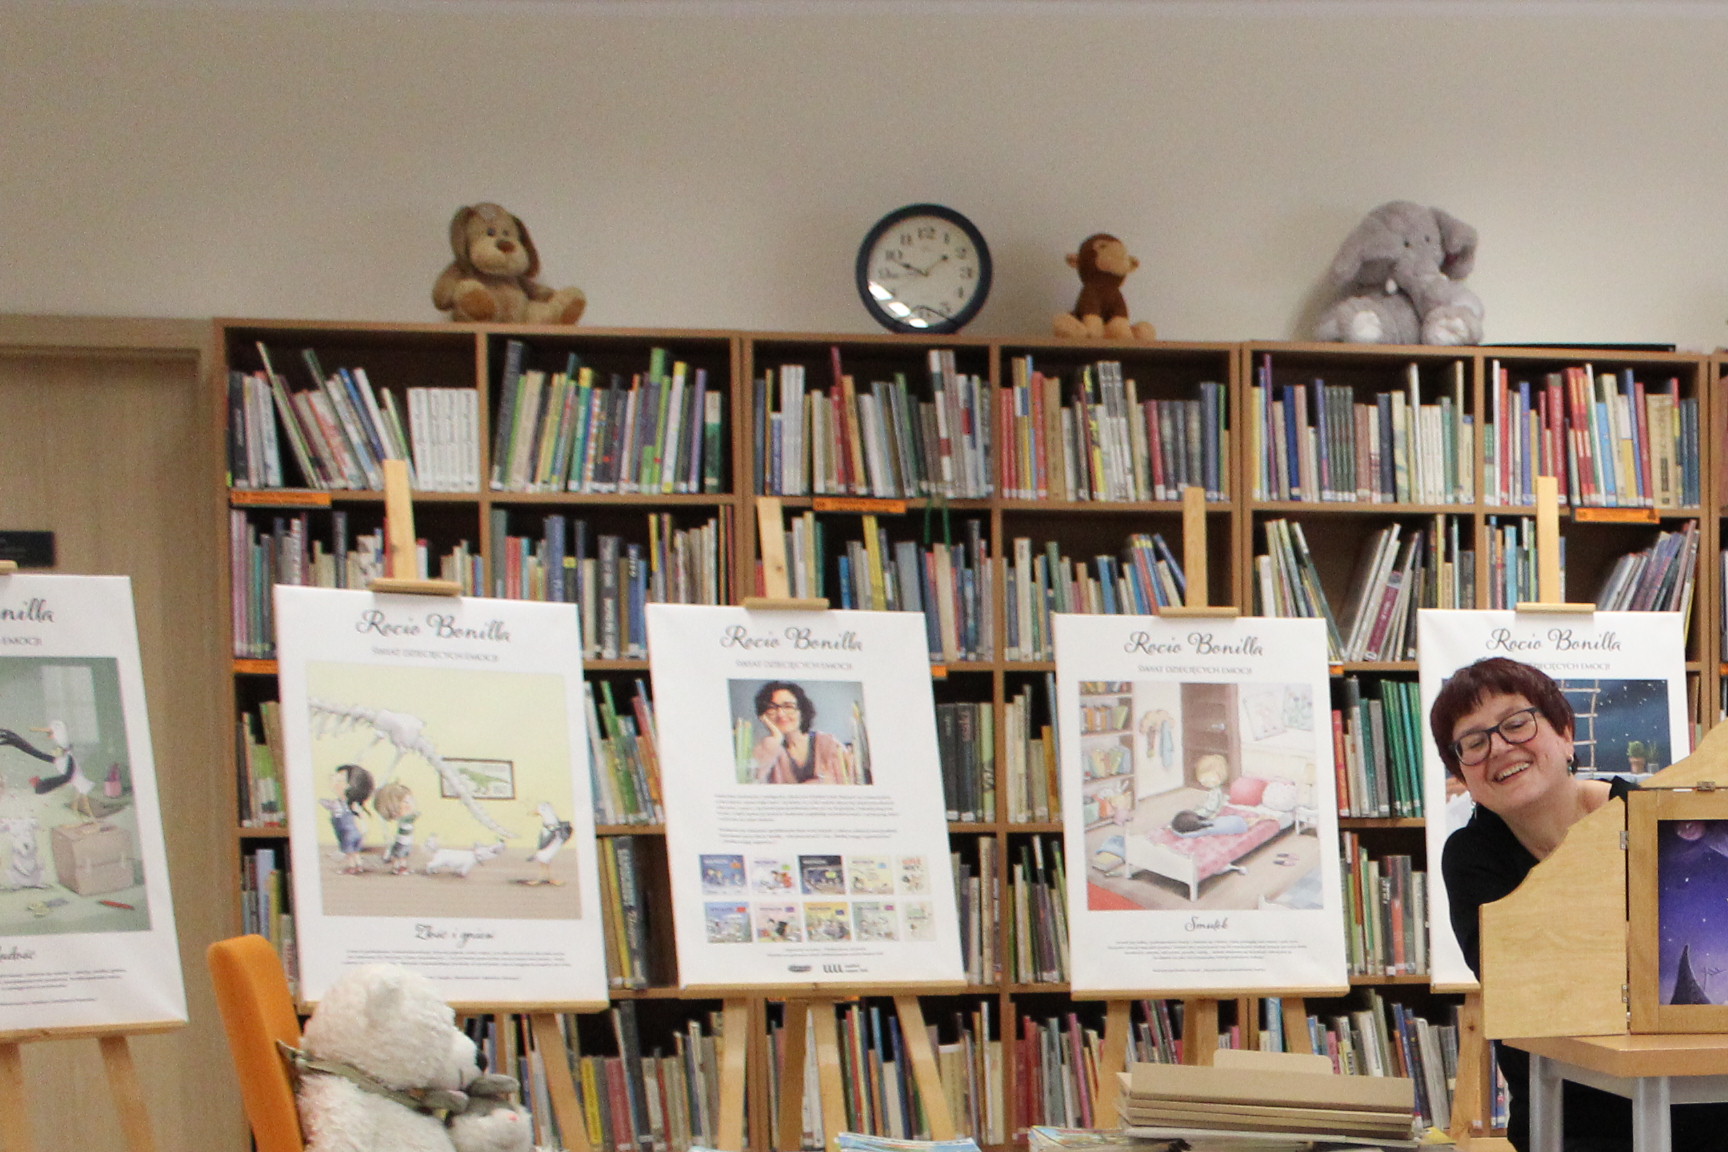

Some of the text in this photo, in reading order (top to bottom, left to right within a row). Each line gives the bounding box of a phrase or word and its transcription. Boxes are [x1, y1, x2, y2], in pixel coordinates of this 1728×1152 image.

[426, 612, 511, 642] Bonilla
[784, 626, 864, 651] Bonilla
[1187, 632, 1263, 656] Bonilla
[1547, 628, 1622, 652] Bonilla
